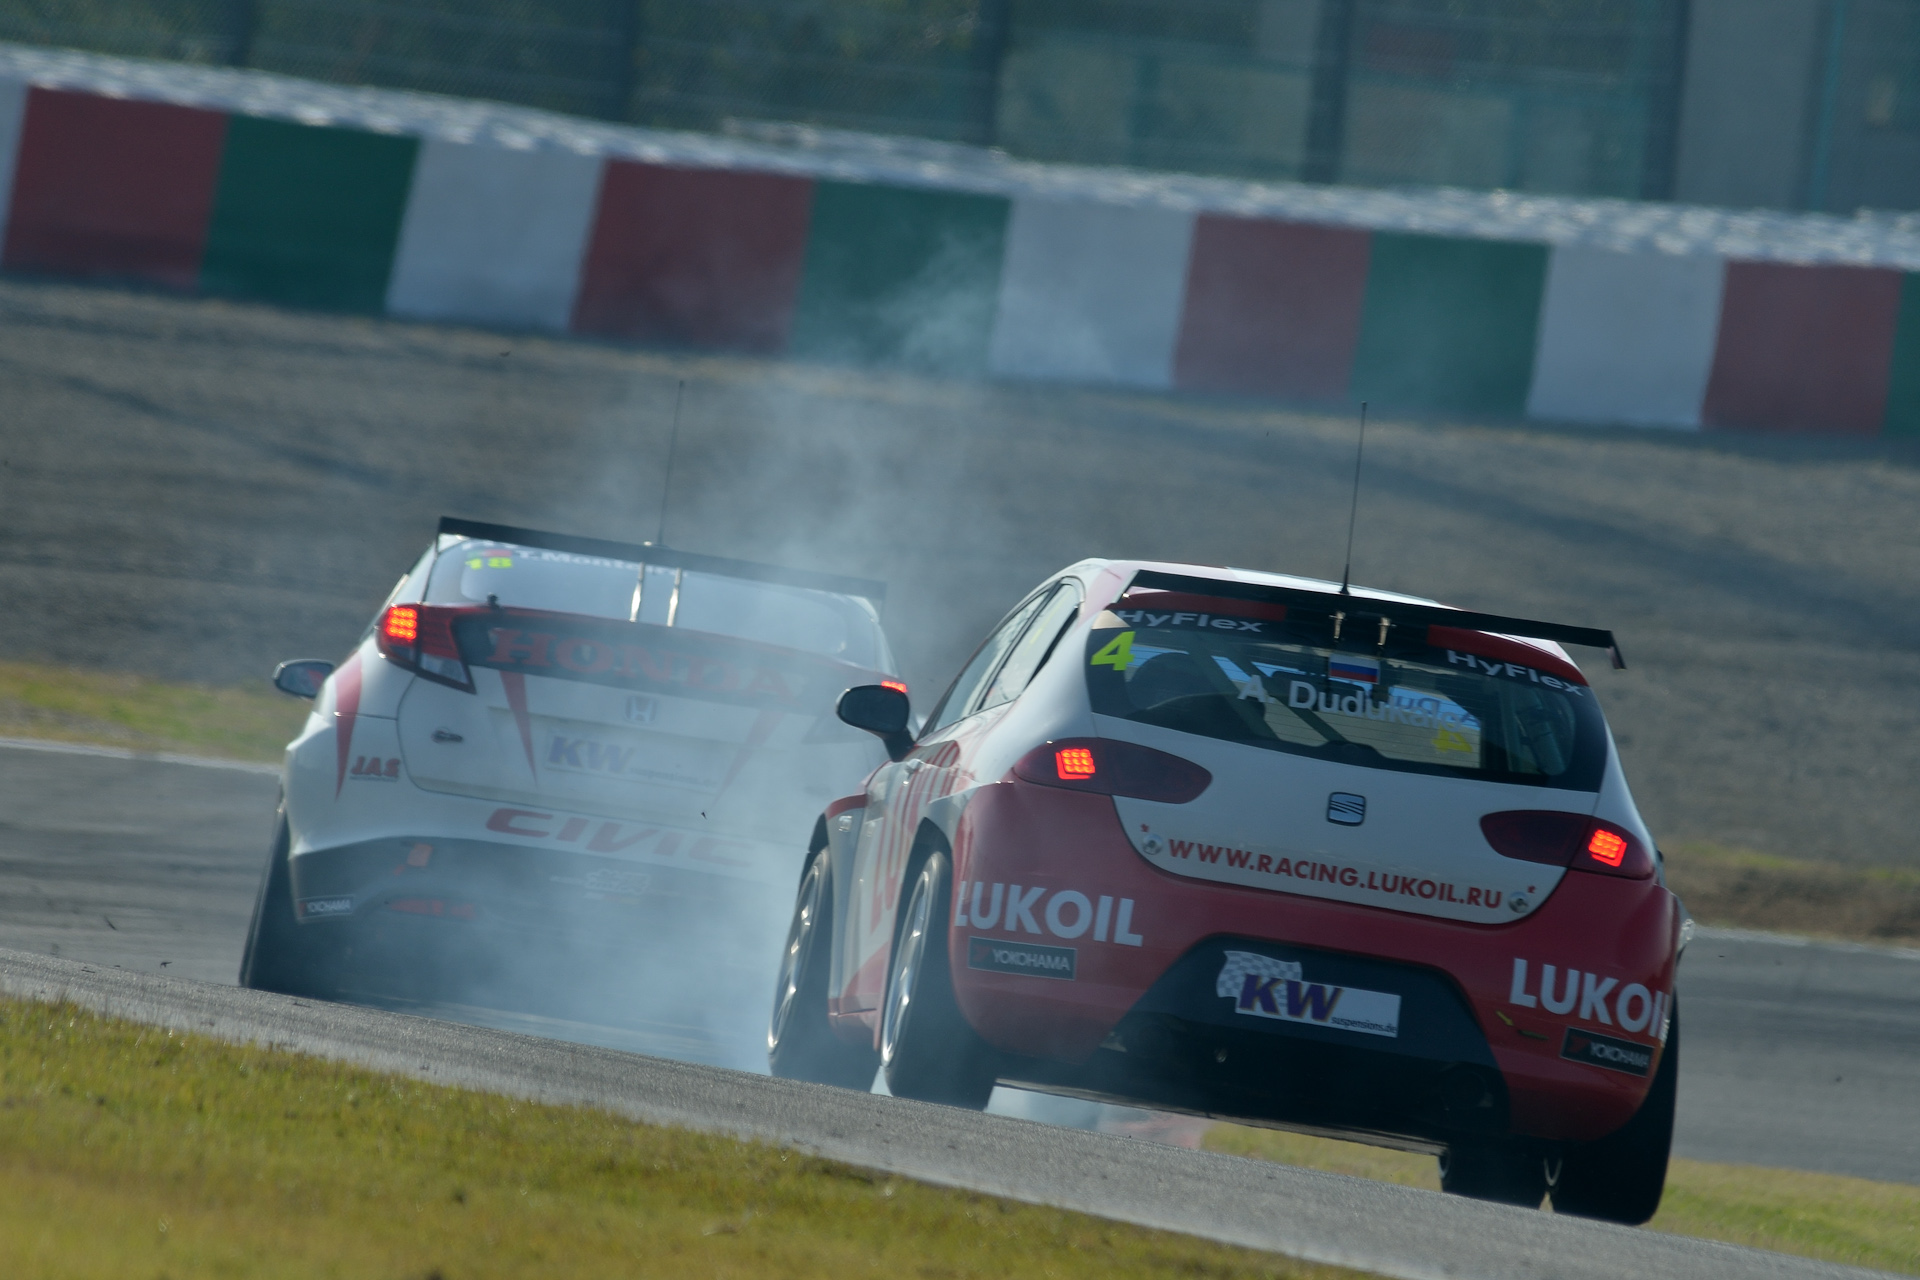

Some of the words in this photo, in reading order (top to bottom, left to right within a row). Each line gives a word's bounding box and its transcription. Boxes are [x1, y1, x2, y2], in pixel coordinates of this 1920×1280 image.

[464, 558, 512, 570] 18
[1115, 610, 1263, 633] HyFlex
[485, 628, 798, 703] HONDA
[1090, 631, 1136, 671] 4
[1238, 674, 1275, 704] A.
[1447, 650, 1584, 697] HyFlex
[549, 735, 634, 773] KW
[485, 808, 754, 868] CIVIC
[1167, 838, 1502, 909] WWW.RACING.LUKOIL.RU
[954, 881, 1144, 947] LUKOIL
[993, 952, 1071, 971] YOKOHAMA
[1239, 973, 1342, 1022] KW
